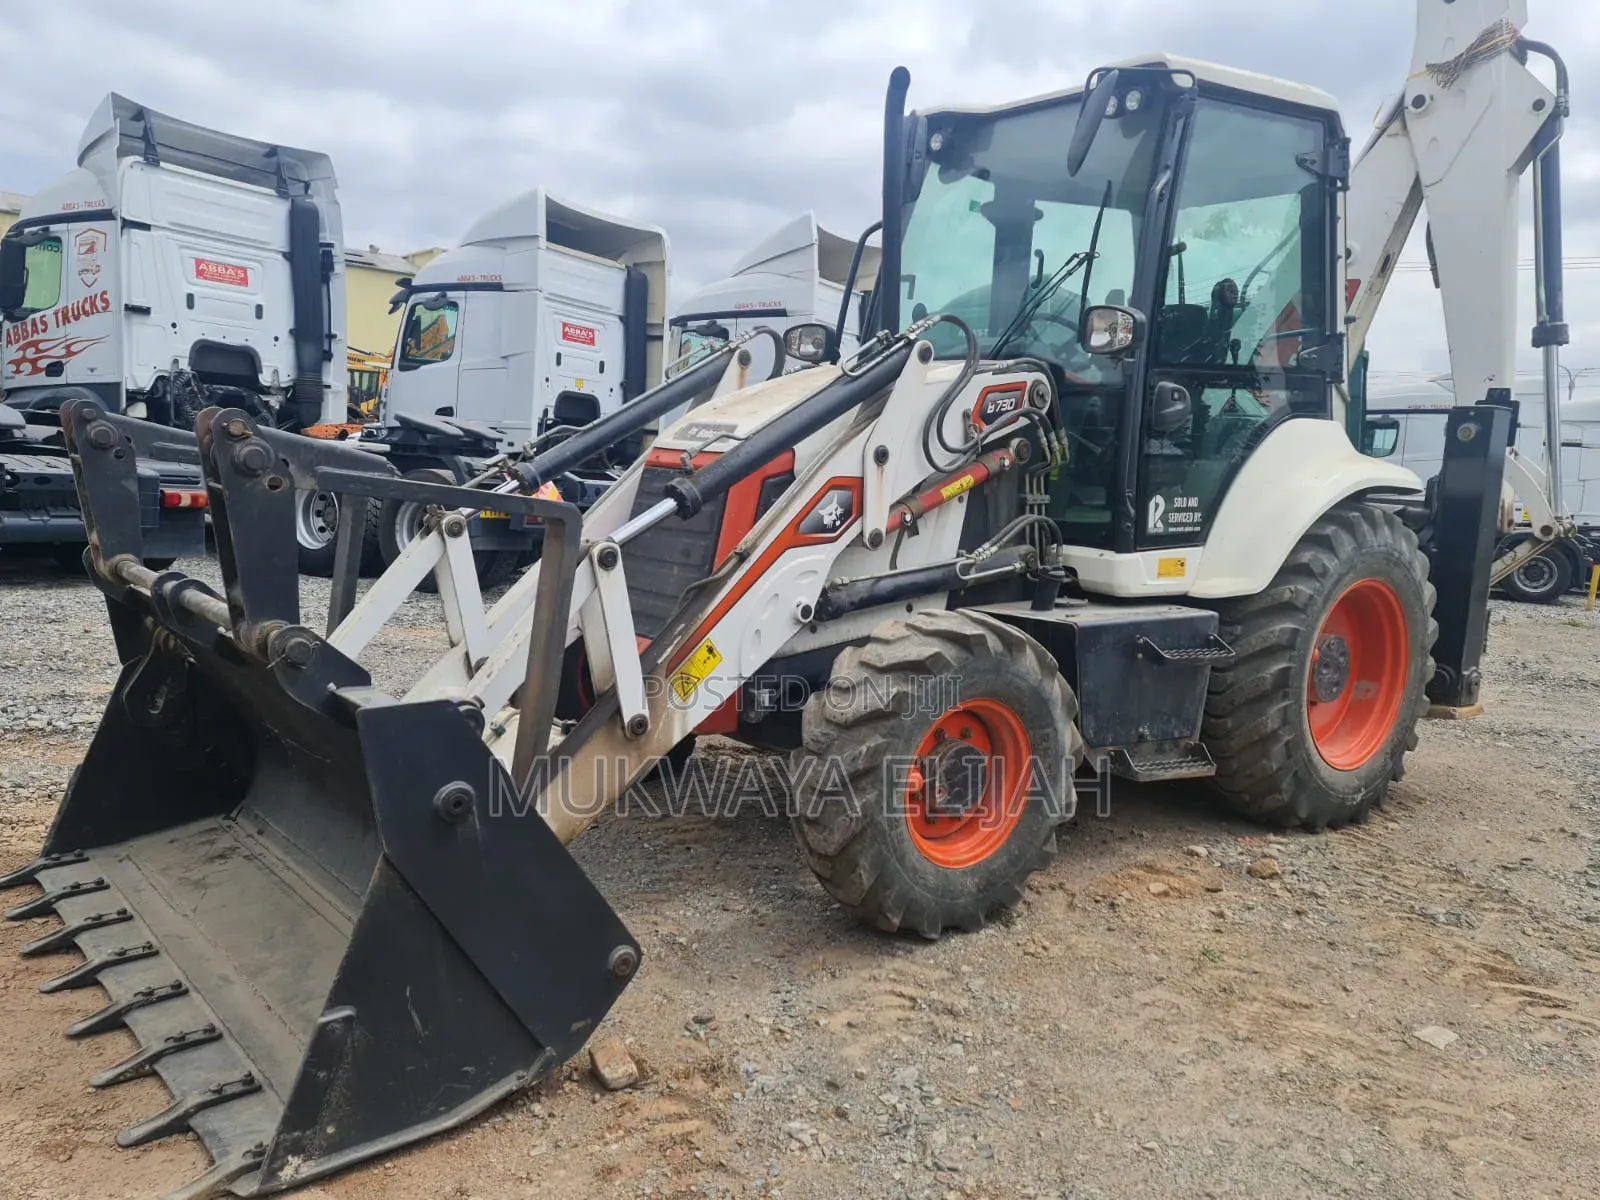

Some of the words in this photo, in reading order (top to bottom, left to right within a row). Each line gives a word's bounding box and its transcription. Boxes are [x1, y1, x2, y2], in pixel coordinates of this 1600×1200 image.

[6, 314, 49, 348] ABBAS
[53, 290, 110, 329] TRUCKS
[1188, 496, 1199, 508] AND
[1168, 512, 1194, 523] SERVICED
